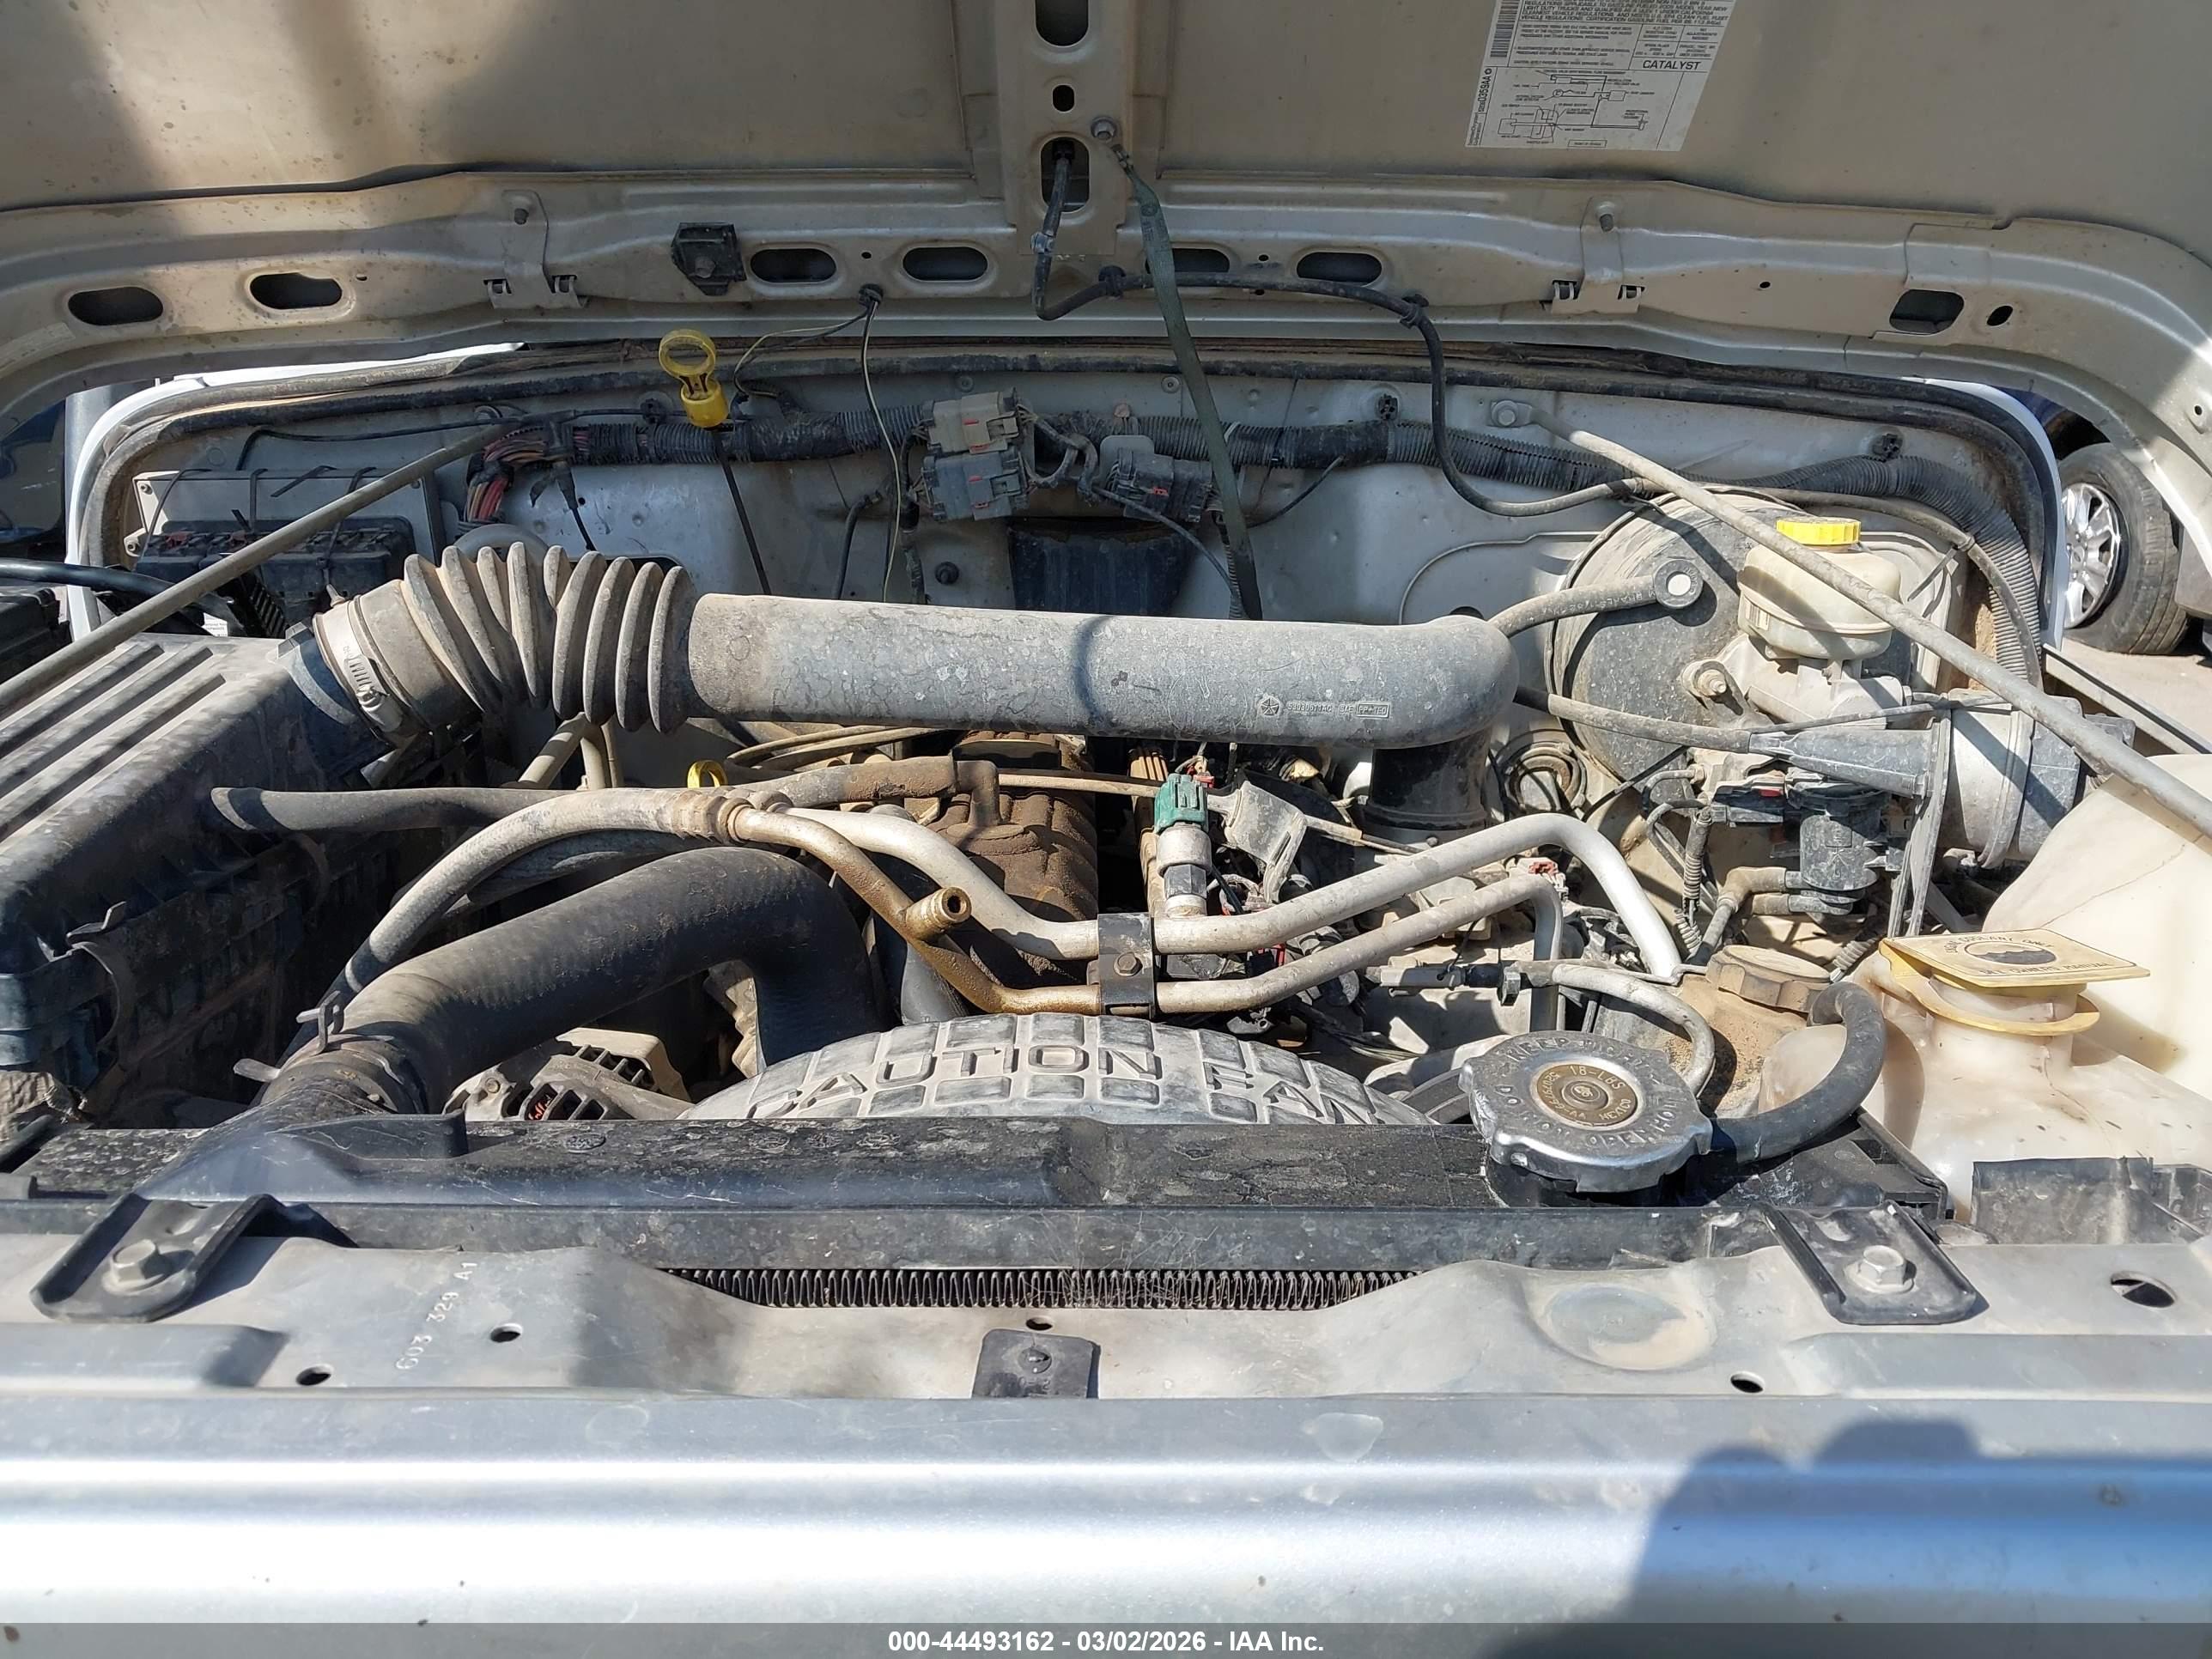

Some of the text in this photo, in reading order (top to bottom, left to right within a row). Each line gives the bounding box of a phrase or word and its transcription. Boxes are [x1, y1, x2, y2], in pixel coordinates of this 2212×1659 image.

[1643, 59, 1701, 70] CATALYST
[745, 1043, 1164, 1119] CAUTION
[1570, 1065, 1626, 1091] 18-LBS
[1599, 1098, 1633, 1121] MEXICO
[453, 1261, 478, 1281] A1
